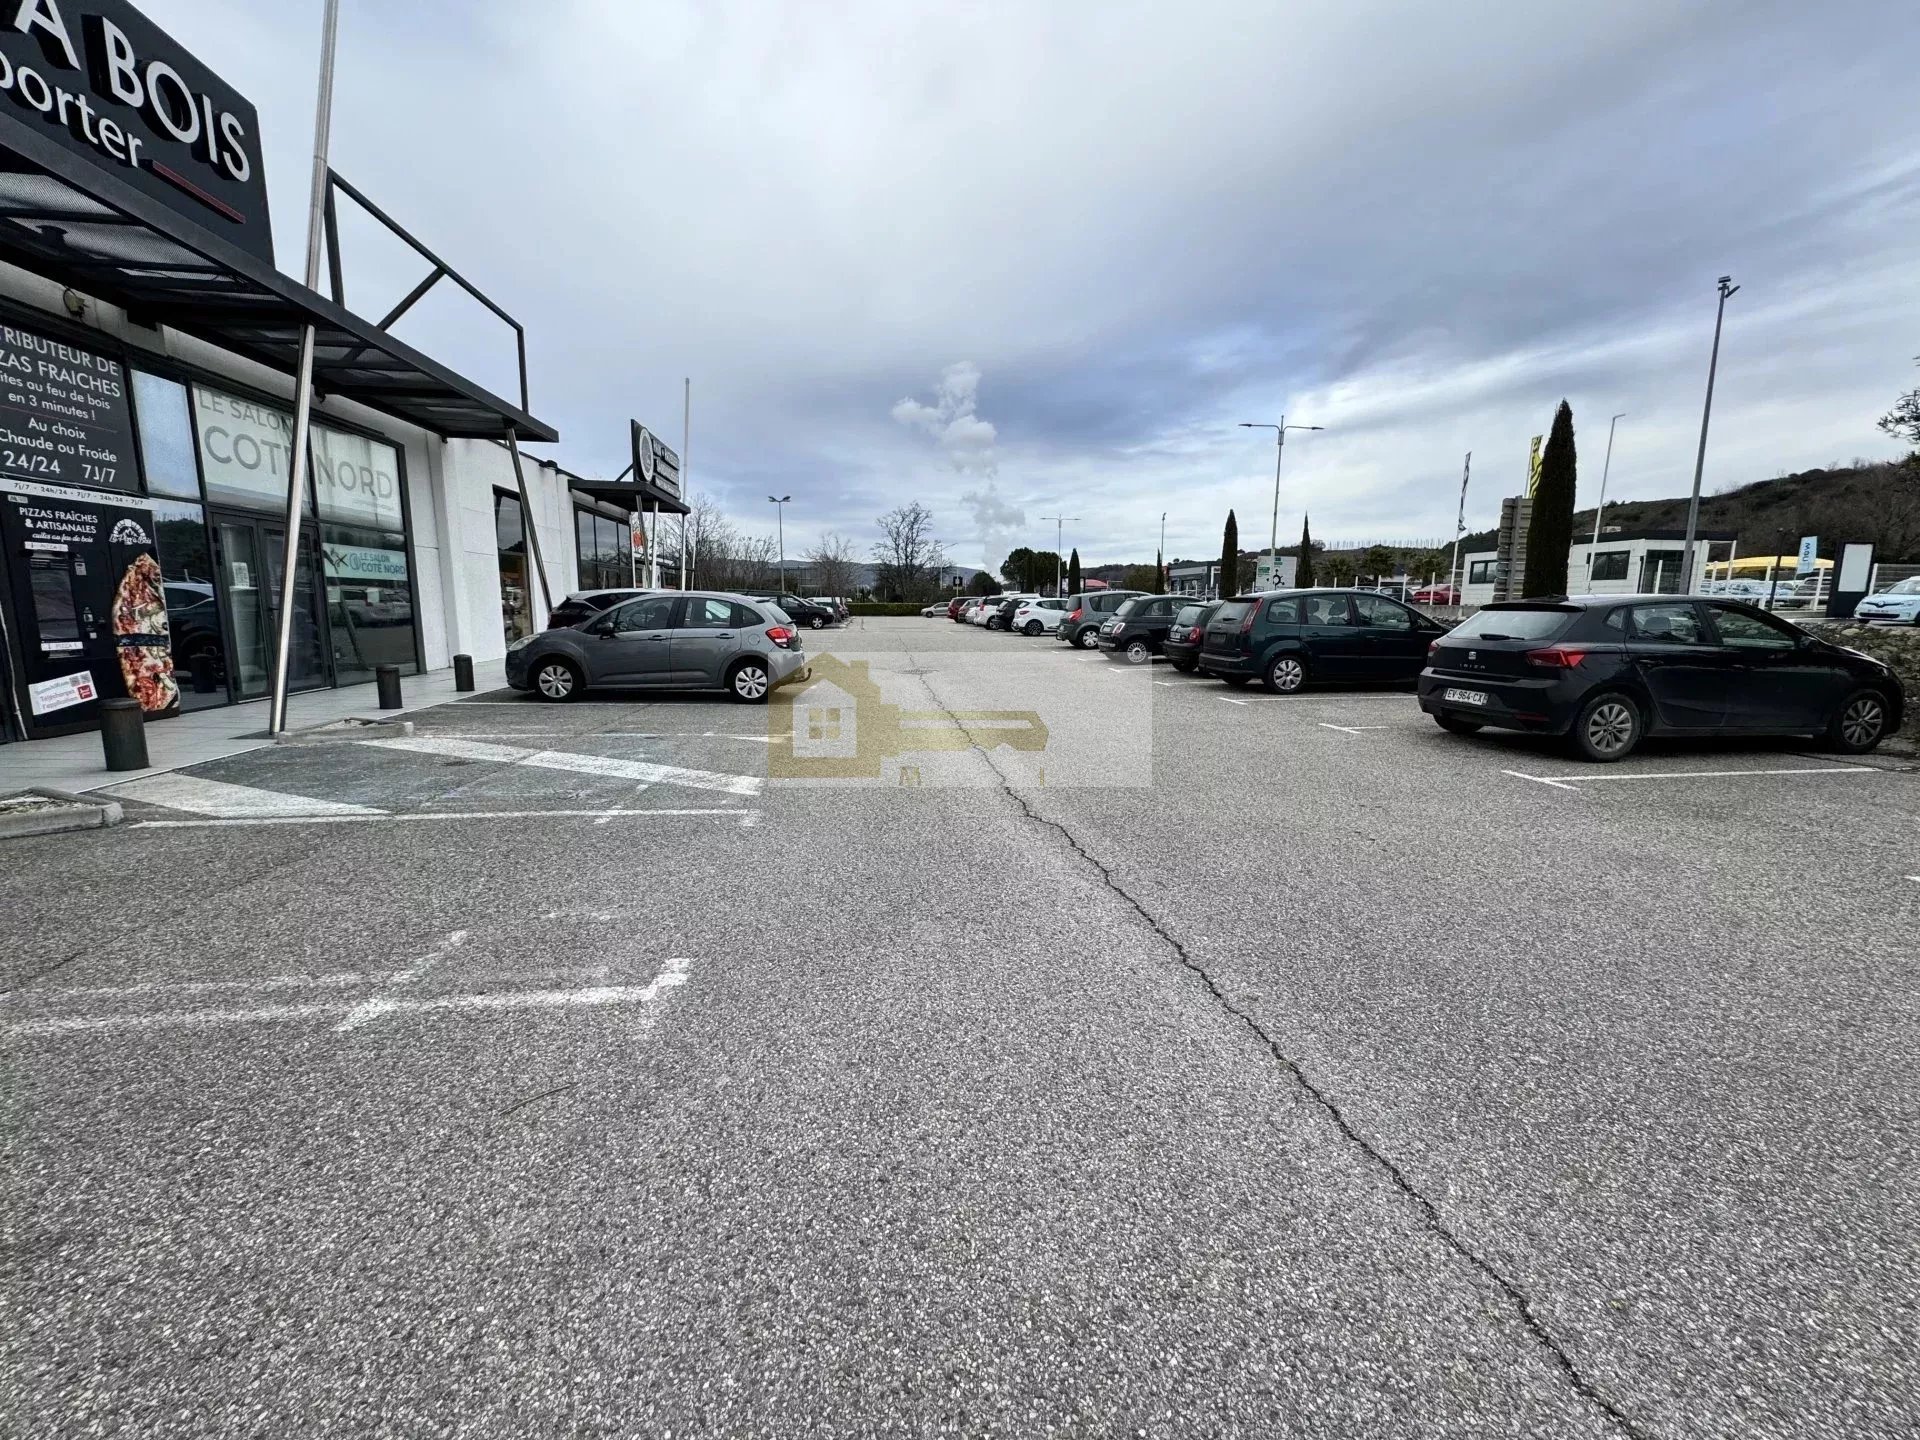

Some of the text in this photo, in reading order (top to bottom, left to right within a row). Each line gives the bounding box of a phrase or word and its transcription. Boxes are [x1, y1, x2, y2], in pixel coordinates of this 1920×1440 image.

[102, 16, 250, 182] BOIS
[0, 325, 119, 377] RIBUTEUR DE
[38, 361, 121, 397] FRAICHES
[8, 392, 25, 404] en
[29, 394, 38, 406] 3
[42, 400, 89, 419] minutes
[27, 381, 43, 392] au
[47, 383, 66, 398] feu
[70, 391, 85, 401] de
[88, 394, 111, 410] bois
[28, 417, 87, 440] Au choix
[199, 389, 294, 445] LE SALON
[0, 428, 118, 462] Chaude ou Froide
[3, 450, 61, 474] 24/24
[316, 454, 392, 499] NORD
[19, 506, 53, 519] PIZZAS
[25, 518, 97, 534] & ARTISANALES
[384, 563, 406, 575] NORD
